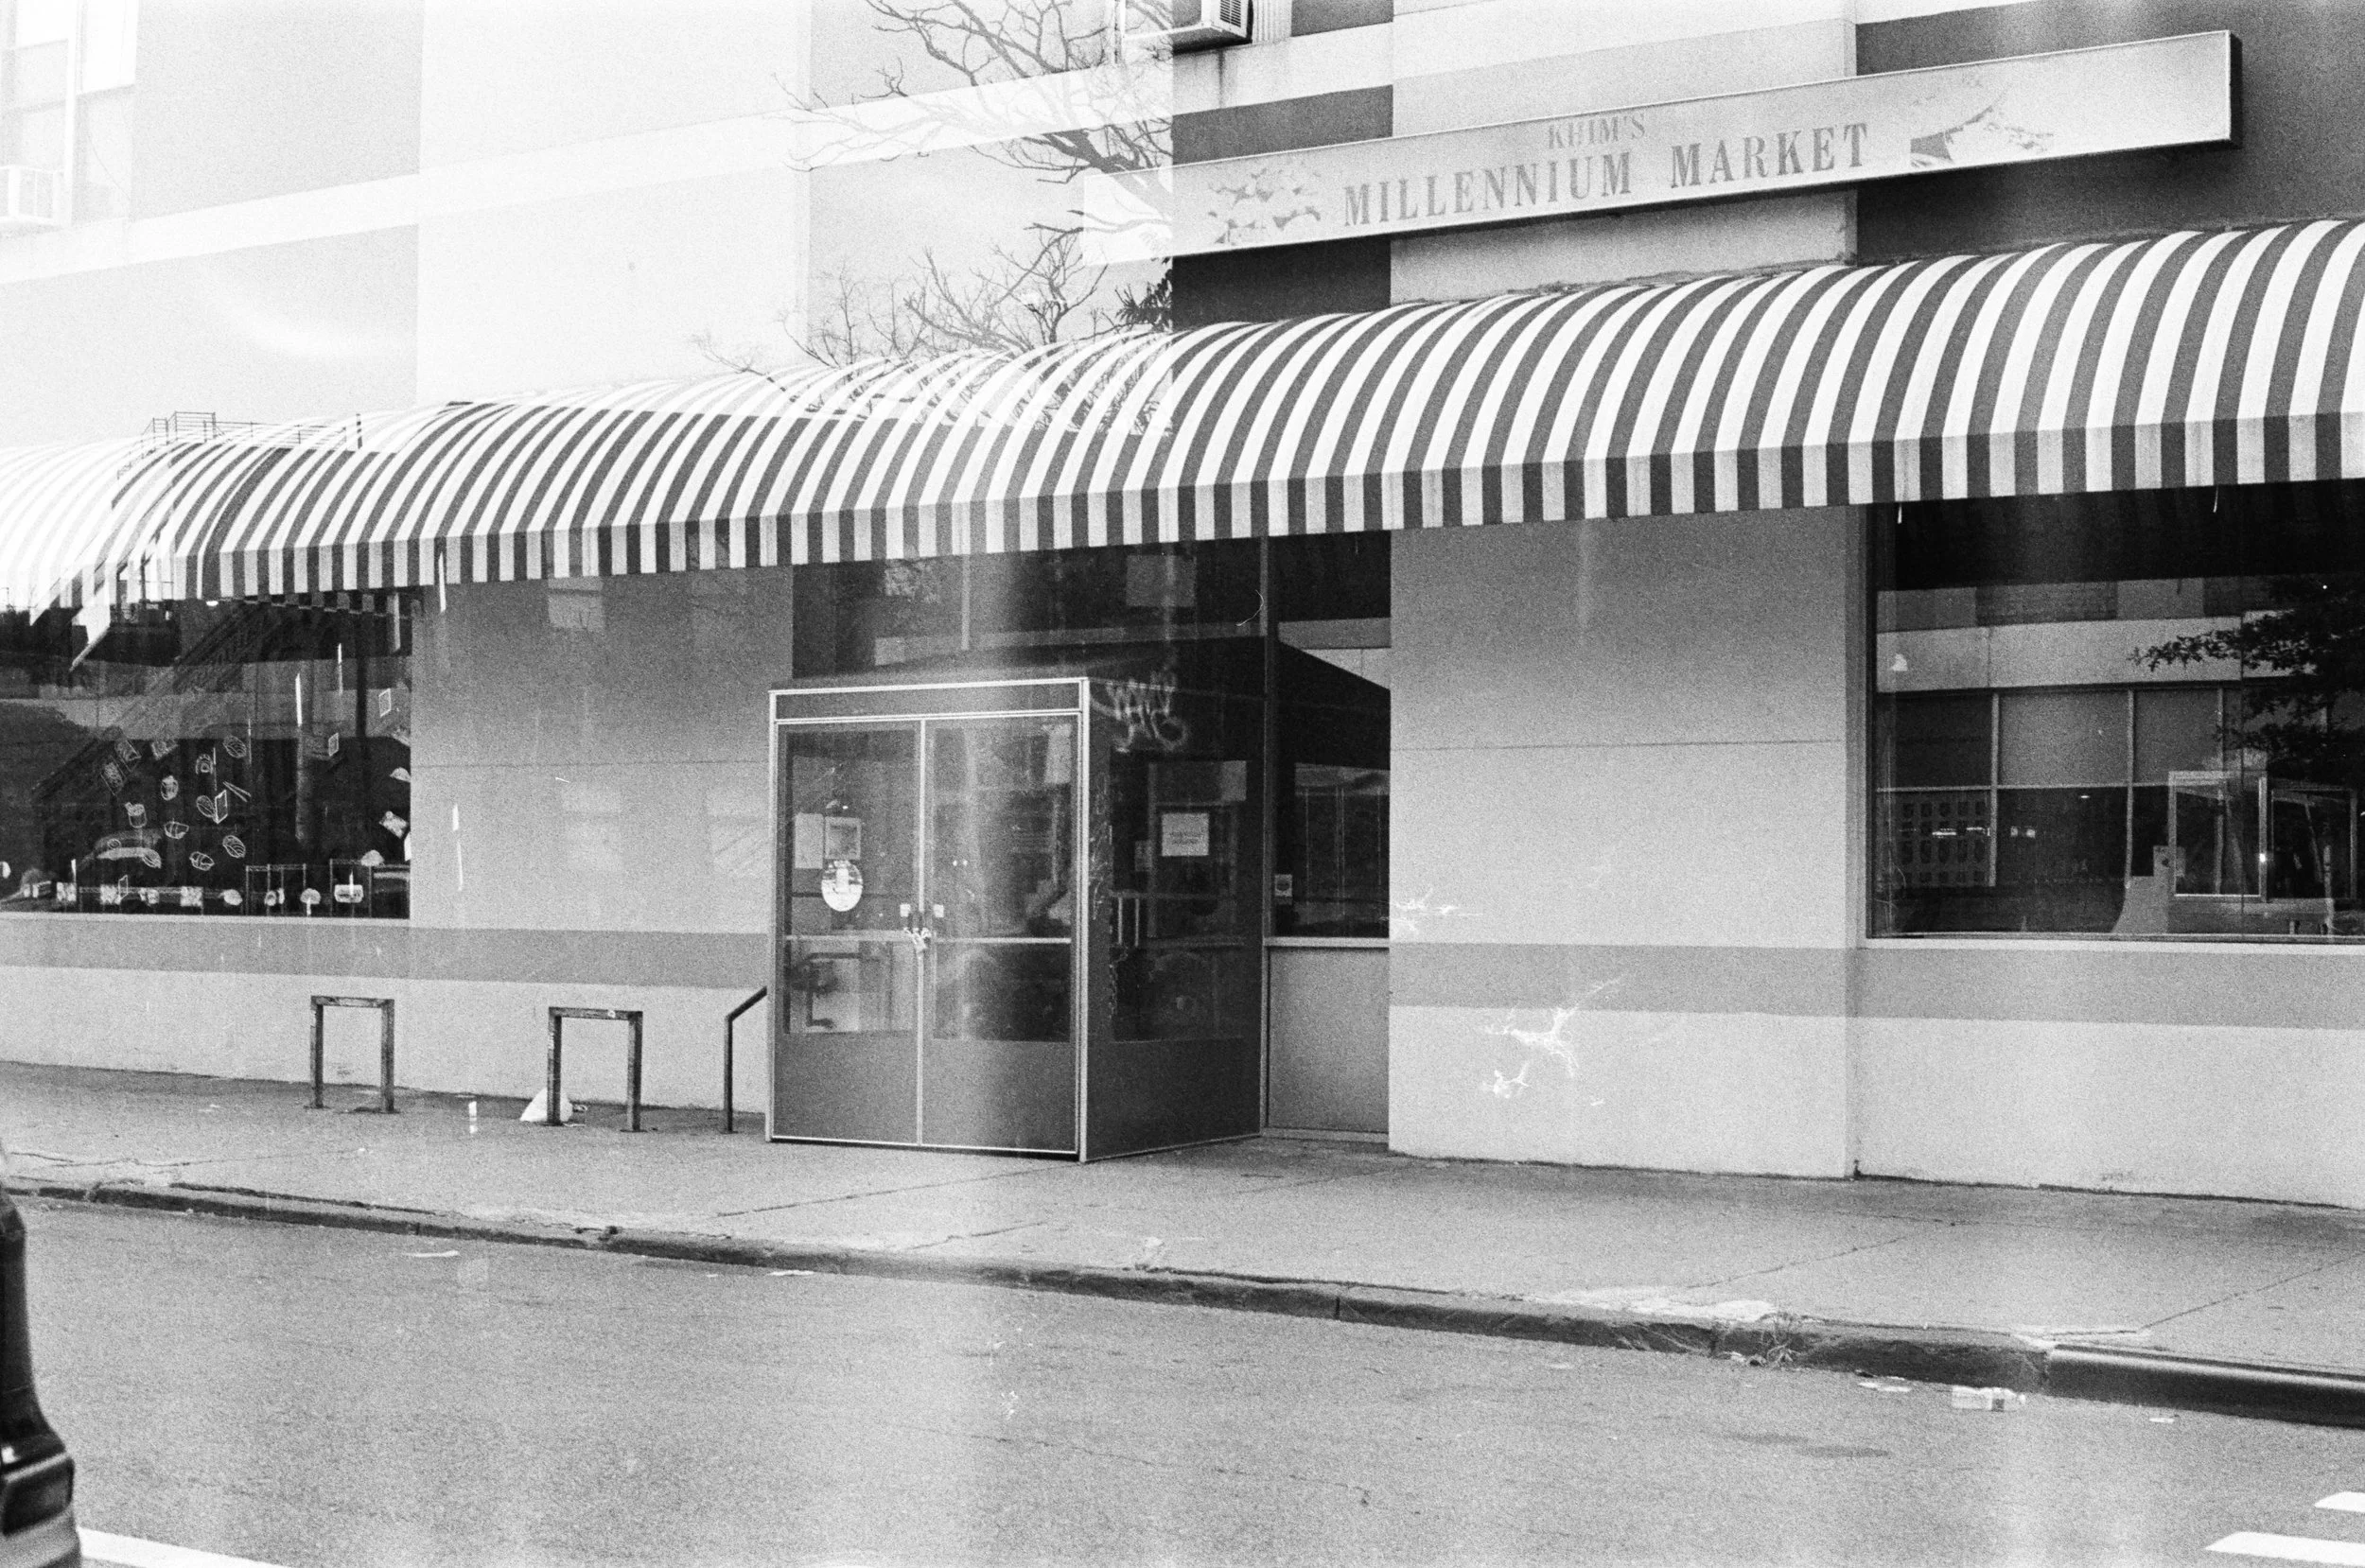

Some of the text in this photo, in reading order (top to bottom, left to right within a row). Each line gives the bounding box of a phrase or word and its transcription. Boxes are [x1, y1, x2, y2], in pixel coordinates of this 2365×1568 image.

[1548, 112, 1646, 150] KHIM'S
[1344, 123, 1869, 228] MILLENNIUM MARKET
